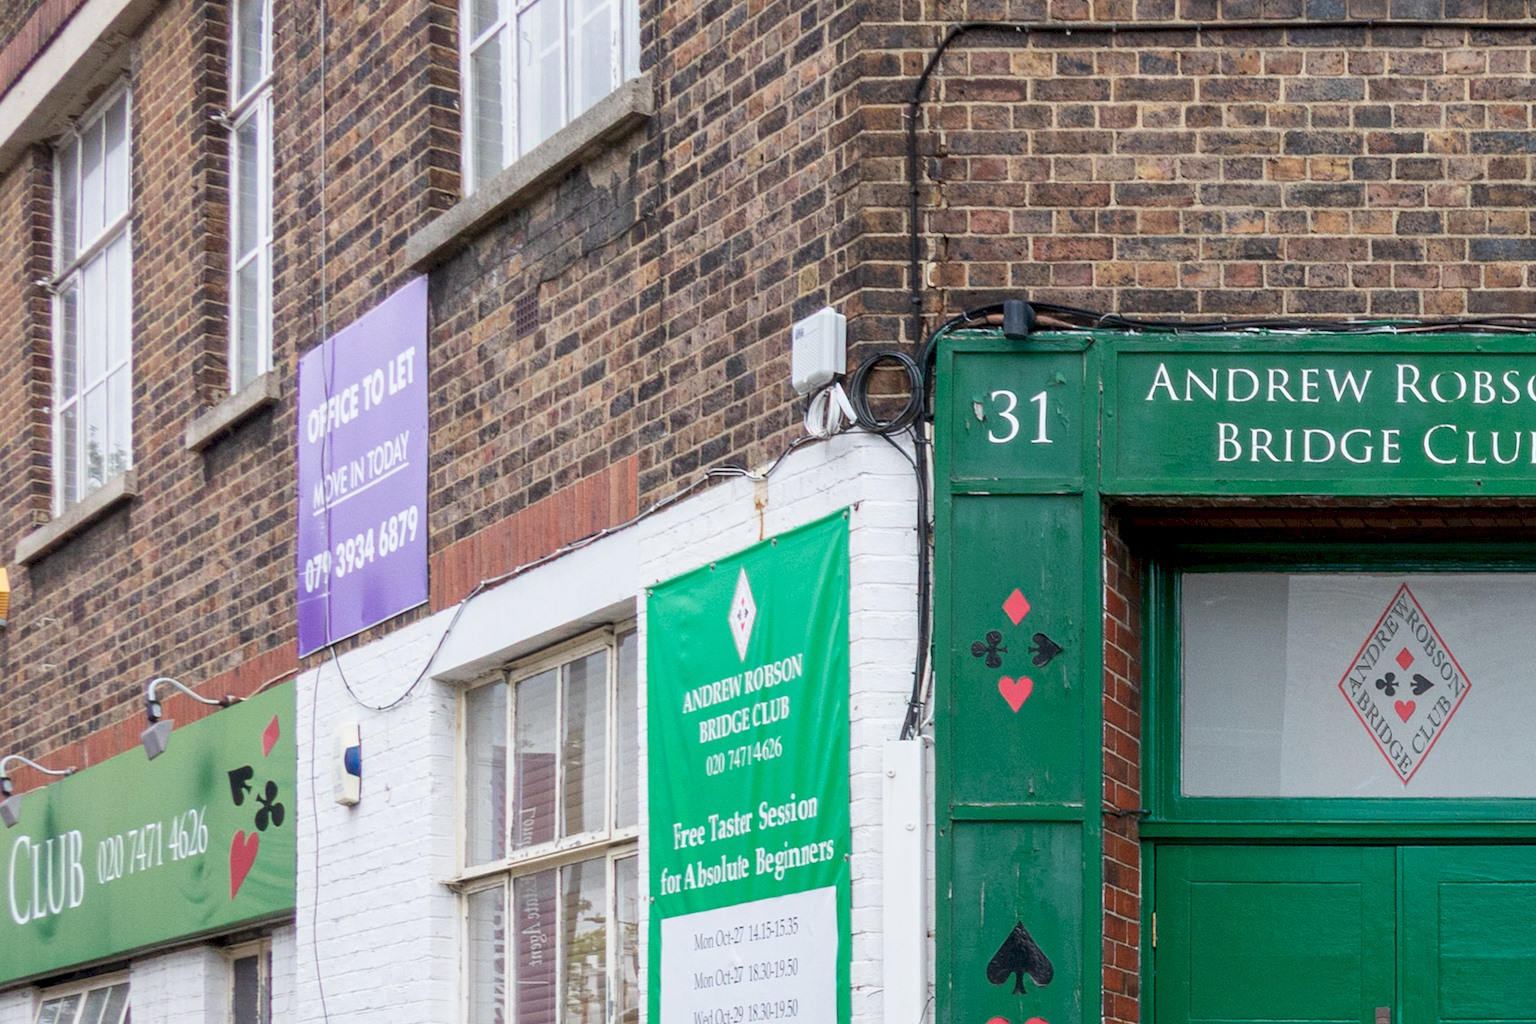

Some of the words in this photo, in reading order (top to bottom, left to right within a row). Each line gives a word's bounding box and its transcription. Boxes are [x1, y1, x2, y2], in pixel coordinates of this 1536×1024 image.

[307, 383, 358, 443] OFFICE
[363, 368, 385, 411] TO
[389, 346, 416, 396] LET
[1145, 362, 1373, 403] ANDREW
[988, 390, 1053, 444] 31
[1216, 422, 1400, 464] BRIDGE
[313, 466, 347, 509] MOVE
[351, 456, 365, 488] IN
[367, 430, 410, 477] TODAY
[305, 551, 331, 593] 079
[335, 528, 375, 578] 3934
[378, 505, 418, 557] 6879
[1347, 593, 1410, 698] ANDREW
[1405, 608, 1466, 698] ROBSON
[682, 674, 742, 714] ANDREW
[744, 653, 803, 694] ROBSON
[699, 707, 750, 744] BRIDGE
[752, 696, 790, 728] CLUB
[1356, 690, 1412, 775] BRIDGE
[1412, 695, 1451, 754] CLUB
[706, 752, 725, 777] 020
[673, 822, 705, 850] Free
[708, 811, 753, 842] Taster
[759, 793, 818, 830] Session
[9, 830, 84, 925] CLUB
[97, 834, 124, 884] 020
[128, 821, 163, 874] 7471
[168, 806, 208, 861] 4626
[660, 868, 682, 895] for
[684, 855, 750, 890] Absolute
[755, 839, 834, 881] Beginners
[694, 933, 714, 951] Mon
[716, 925, 744, 947] Oct-27
[749, 916, 799, 941] 14.15-15.35
[694, 972, 714, 990] Mon
[716, 966, 744, 986] Oct-27
[748, 957, 799, 982] 18.30-19.50
[748, 999, 799, 1022] 18.30-19.50
